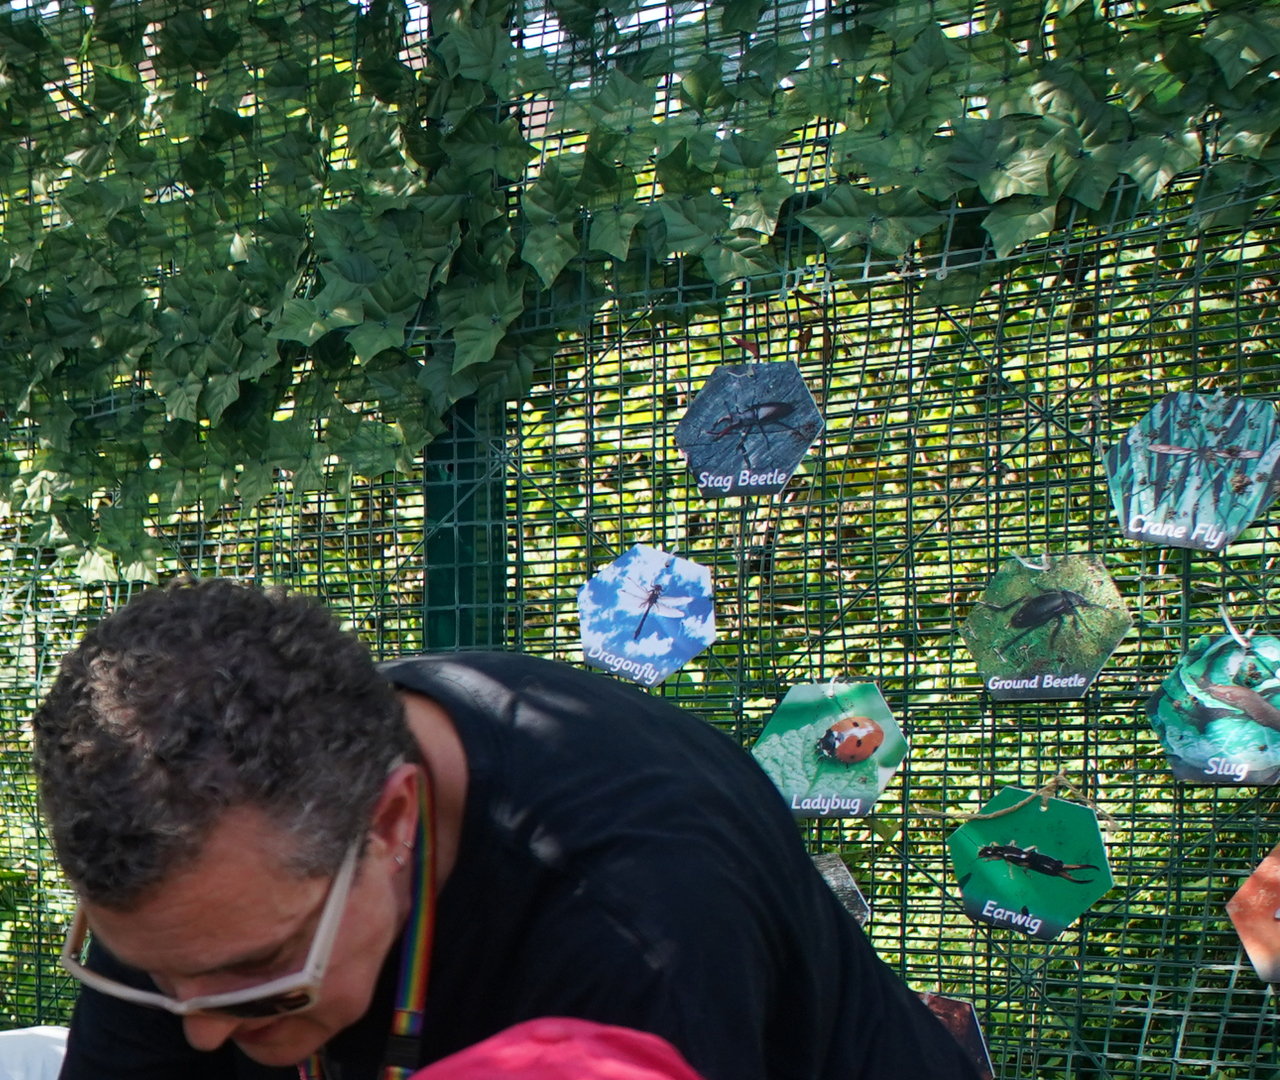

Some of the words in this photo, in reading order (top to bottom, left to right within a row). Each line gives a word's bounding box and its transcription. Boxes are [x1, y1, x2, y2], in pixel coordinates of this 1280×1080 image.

[697, 471, 733, 492] Stag
[738, 468, 786, 486] Beetle
[1128, 514, 1187, 538] Crane
[1190, 522, 1227, 549] Fly
[587, 646, 659, 685] Dragonfly
[988, 675, 1040, 690] Ground
[1042, 674, 1086, 688] Beetle
[1203, 757, 1251, 782] Slug
[791, 794, 861, 815] Ladybug
[982, 900, 1042, 935] Earwig
